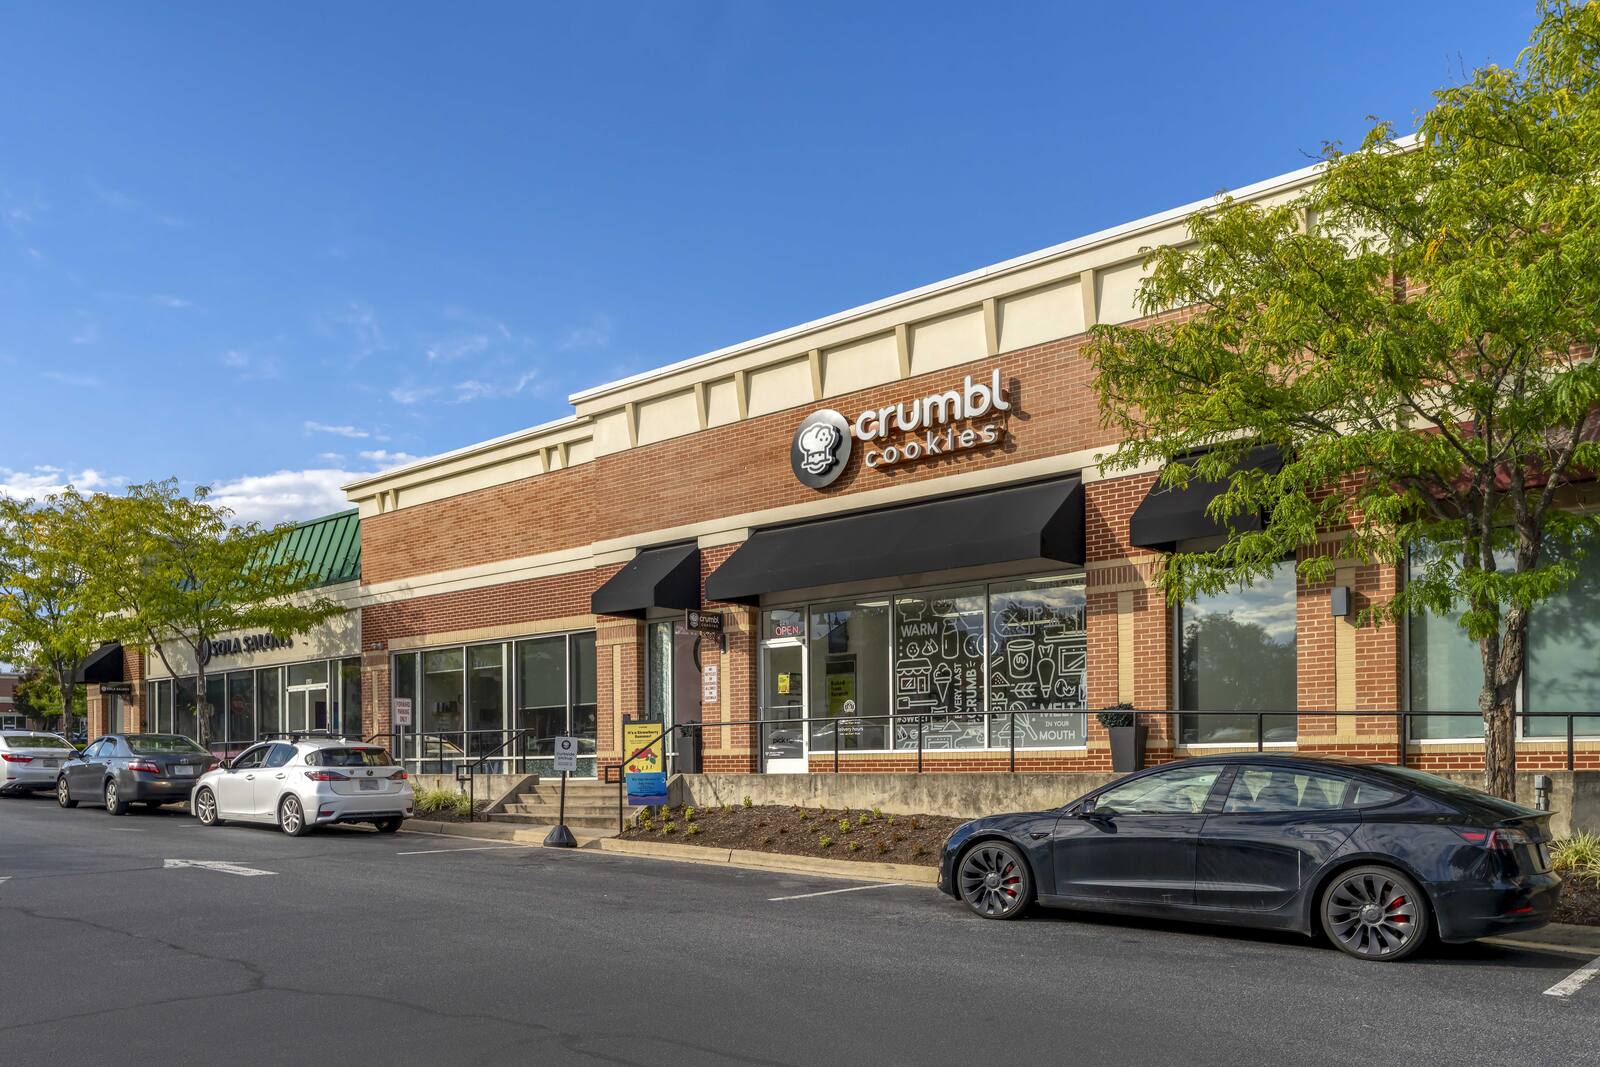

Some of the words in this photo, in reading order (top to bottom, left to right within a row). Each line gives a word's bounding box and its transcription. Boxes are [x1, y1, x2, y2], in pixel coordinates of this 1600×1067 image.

[855, 368, 1011, 441] crumbl
[865, 424, 998, 467] cookies
[775, 625, 800, 635] OPEN
[901, 622, 938, 638] WARM
[954, 663, 962, 686] LAST
[954, 689, 962, 719] EVERY
[966, 669, 977, 719] CRUMB
[1040, 702, 1076, 717] MELT
[1039, 730, 1075, 740] MOUTH
